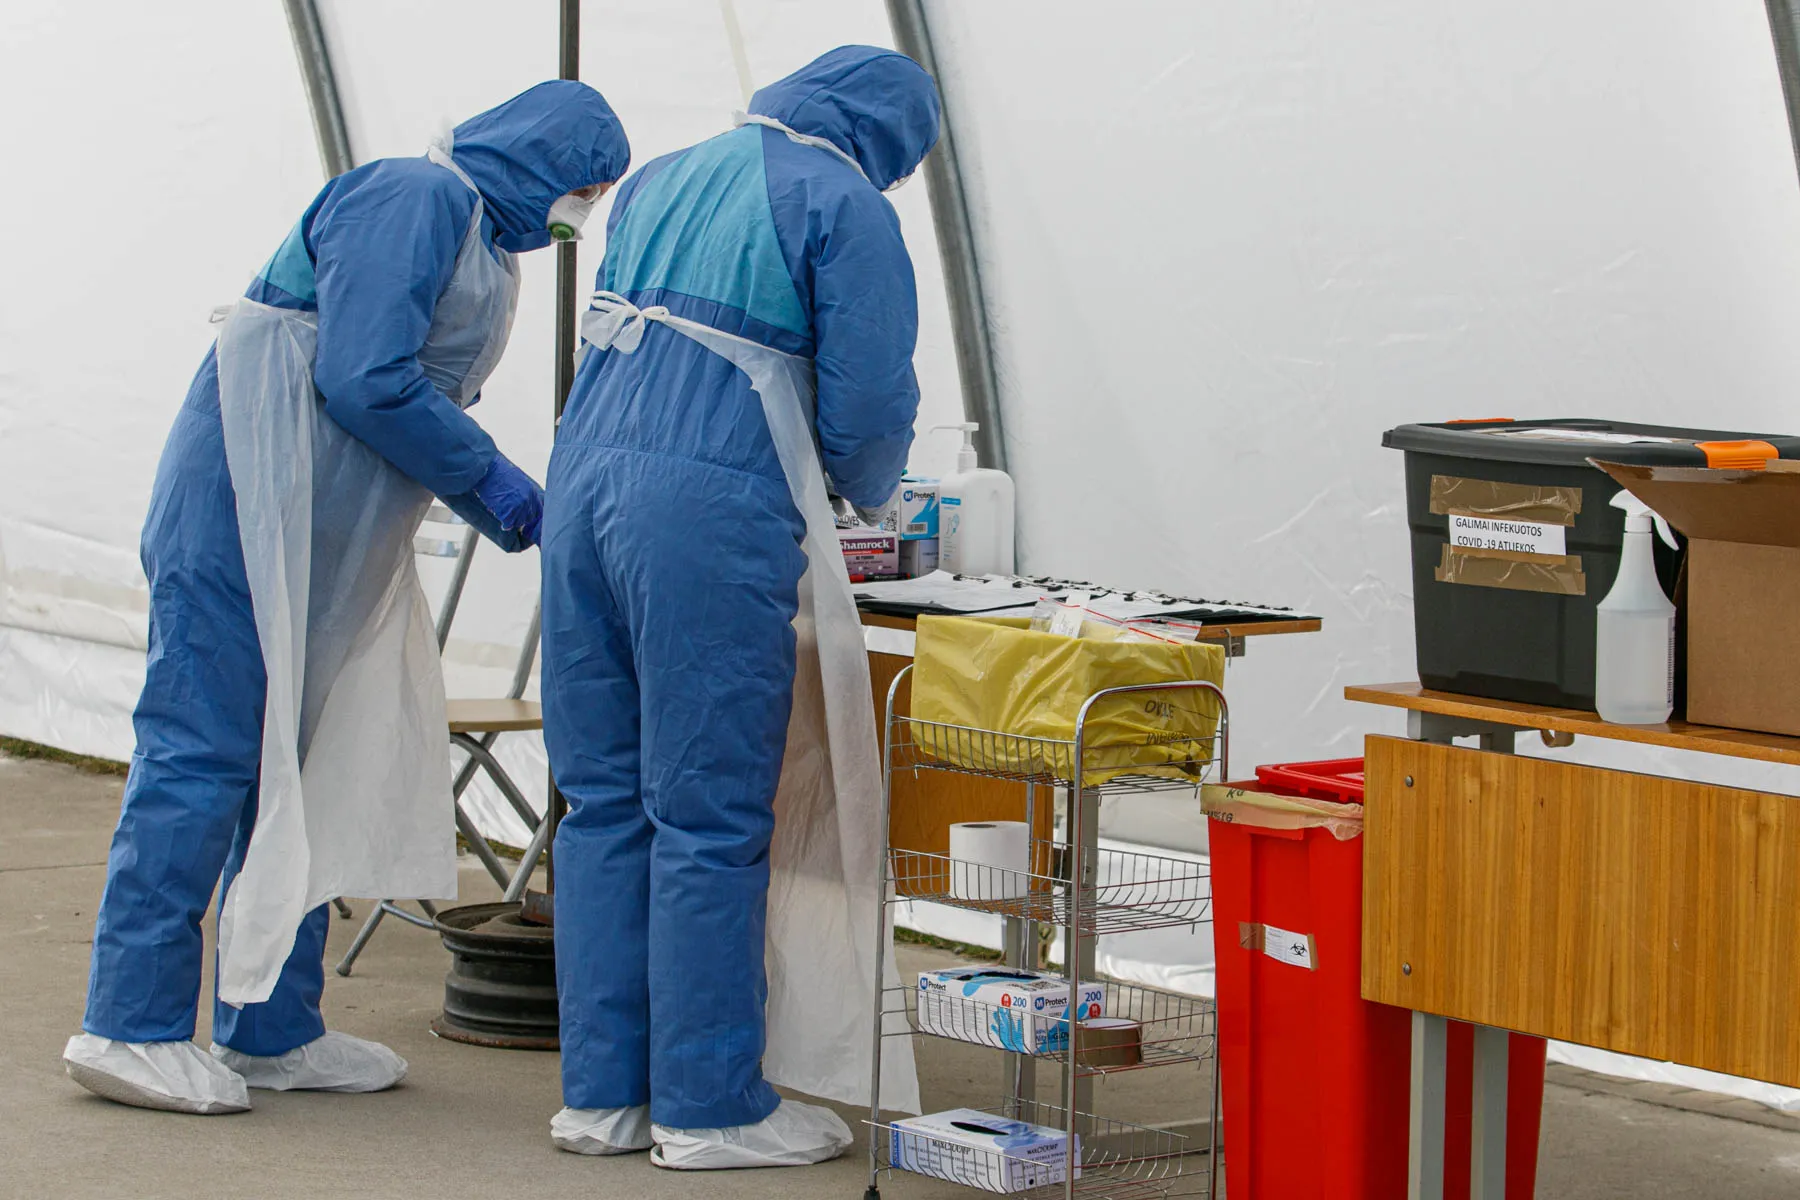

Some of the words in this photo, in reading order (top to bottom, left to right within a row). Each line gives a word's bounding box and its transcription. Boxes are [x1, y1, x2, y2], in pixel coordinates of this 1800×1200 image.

[914, 491, 935, 500] Protect
[1456, 517, 1490, 530] GALIMAI
[1491, 522, 1542, 536] INFEKUOTOS
[1457, 536, 1483, 547] COVID
[1484, 539, 1496, 550] -19
[1498, 540, 1536, 553] ATLIEKOS
[929, 981, 946, 991] Protect
[1013, 996, 1027, 1008] 200
[1045, 997, 1068, 1006] Protect
[1085, 990, 1102, 1002] 200
